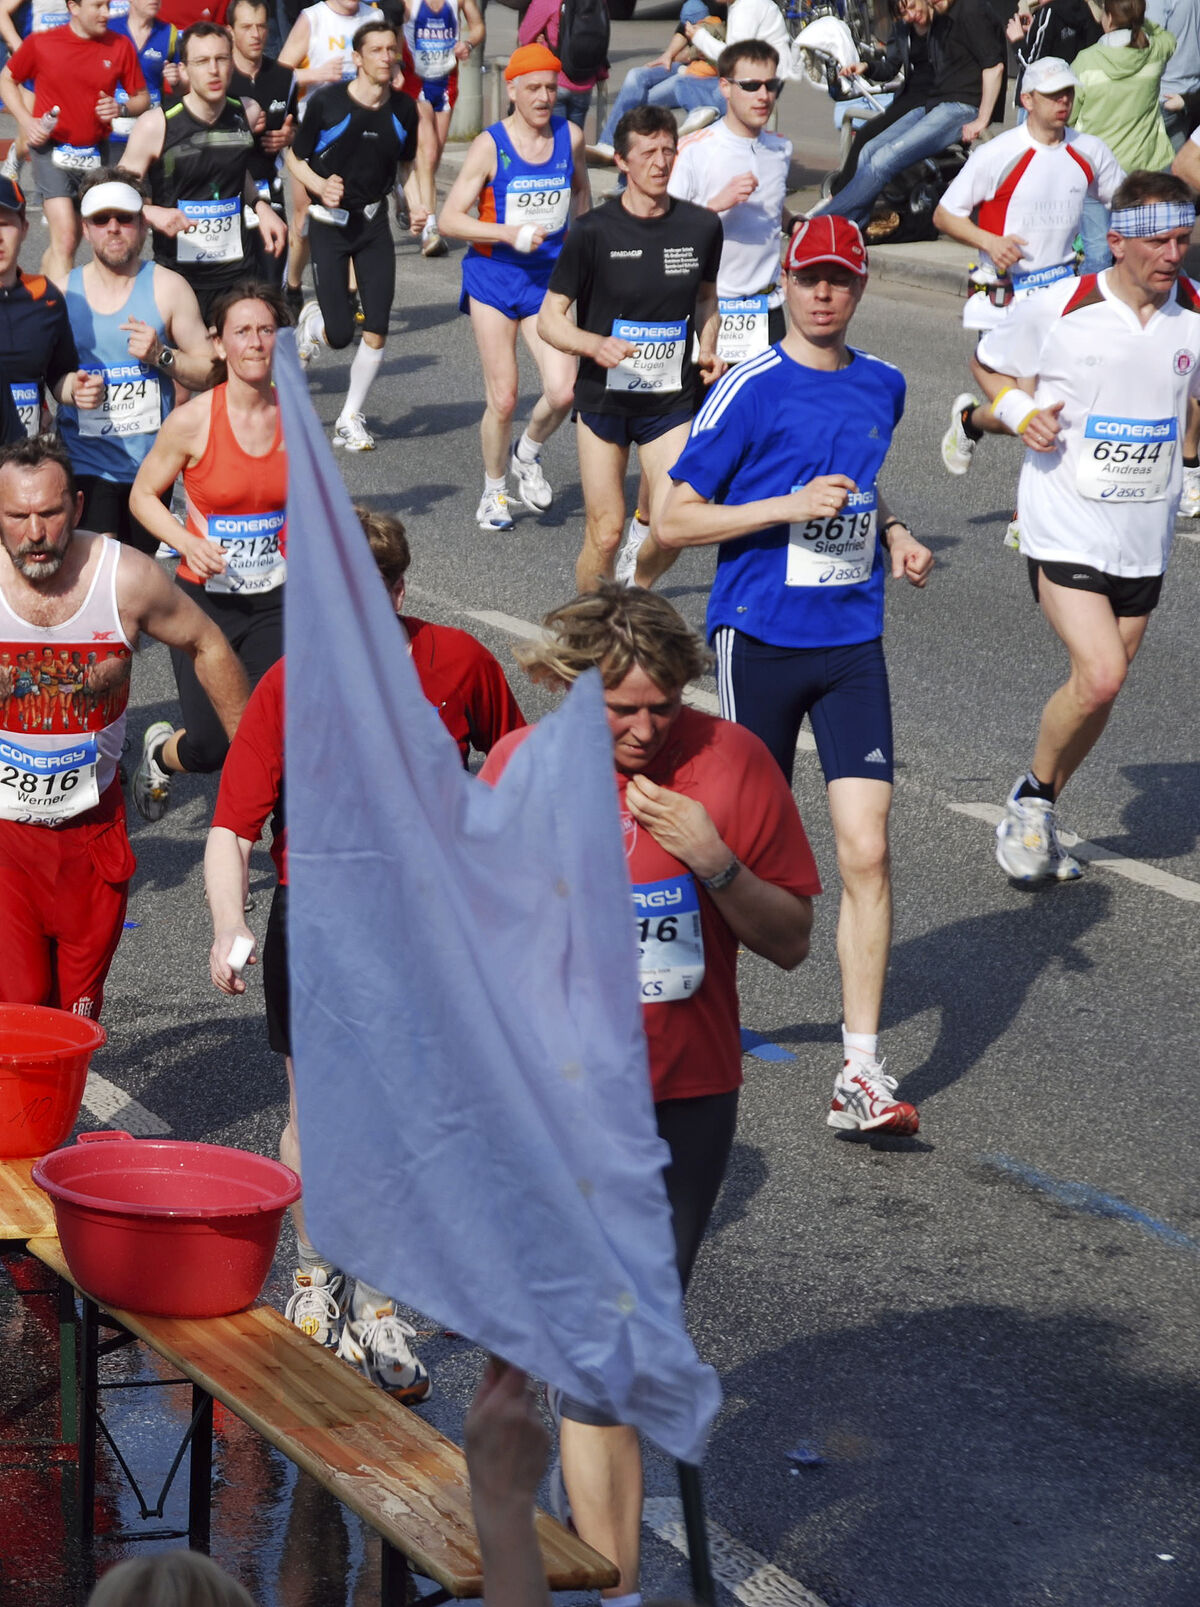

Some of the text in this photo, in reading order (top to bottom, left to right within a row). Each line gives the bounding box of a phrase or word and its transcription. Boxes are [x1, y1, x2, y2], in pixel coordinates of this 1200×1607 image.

[517, 190, 562, 208] 930
[718, 314, 756, 332] 636
[632, 341, 676, 360] 5008
[103, 401, 136, 412] Bernd
[1093, 441, 1163, 464] 6544
[1101, 463, 1153, 475] Andreas
[803, 513, 871, 541] 5619
[814, 539, 866, 555] Siegfried
[0, 766, 81, 796] 2816
[17, 790, 67, 806] Werner
[637, 916, 679, 943] 16
